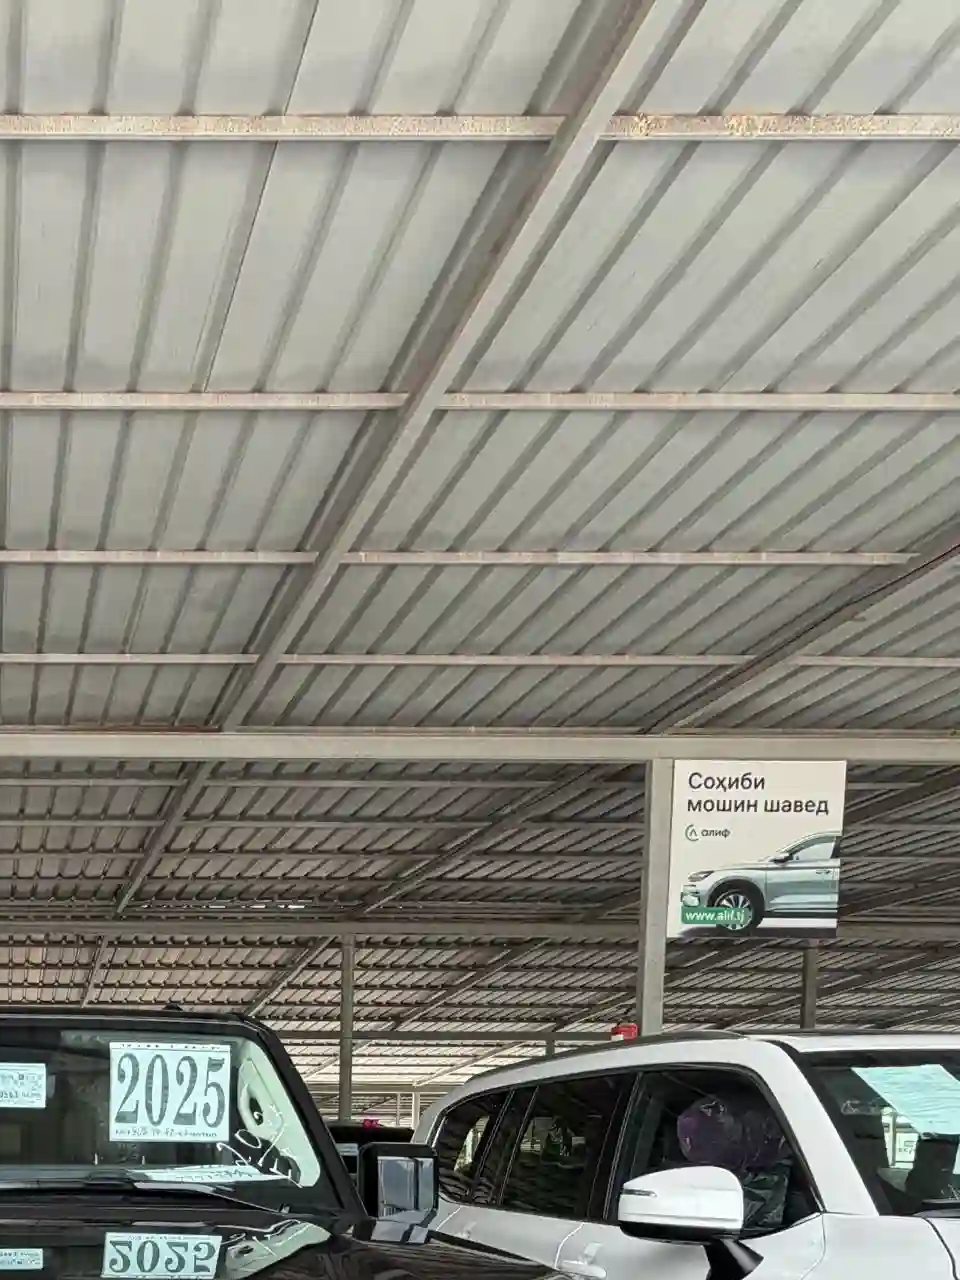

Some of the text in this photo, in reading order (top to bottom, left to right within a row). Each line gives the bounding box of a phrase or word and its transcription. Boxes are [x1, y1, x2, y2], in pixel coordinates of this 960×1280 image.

[688, 772, 765, 792] Соҳиби
[687, 799, 829, 816] мошин шавед
[701, 828, 731, 840] алиф
[685, 909, 745, 923] www.alif.tj
[115, 1053, 225, 1128] 2025
